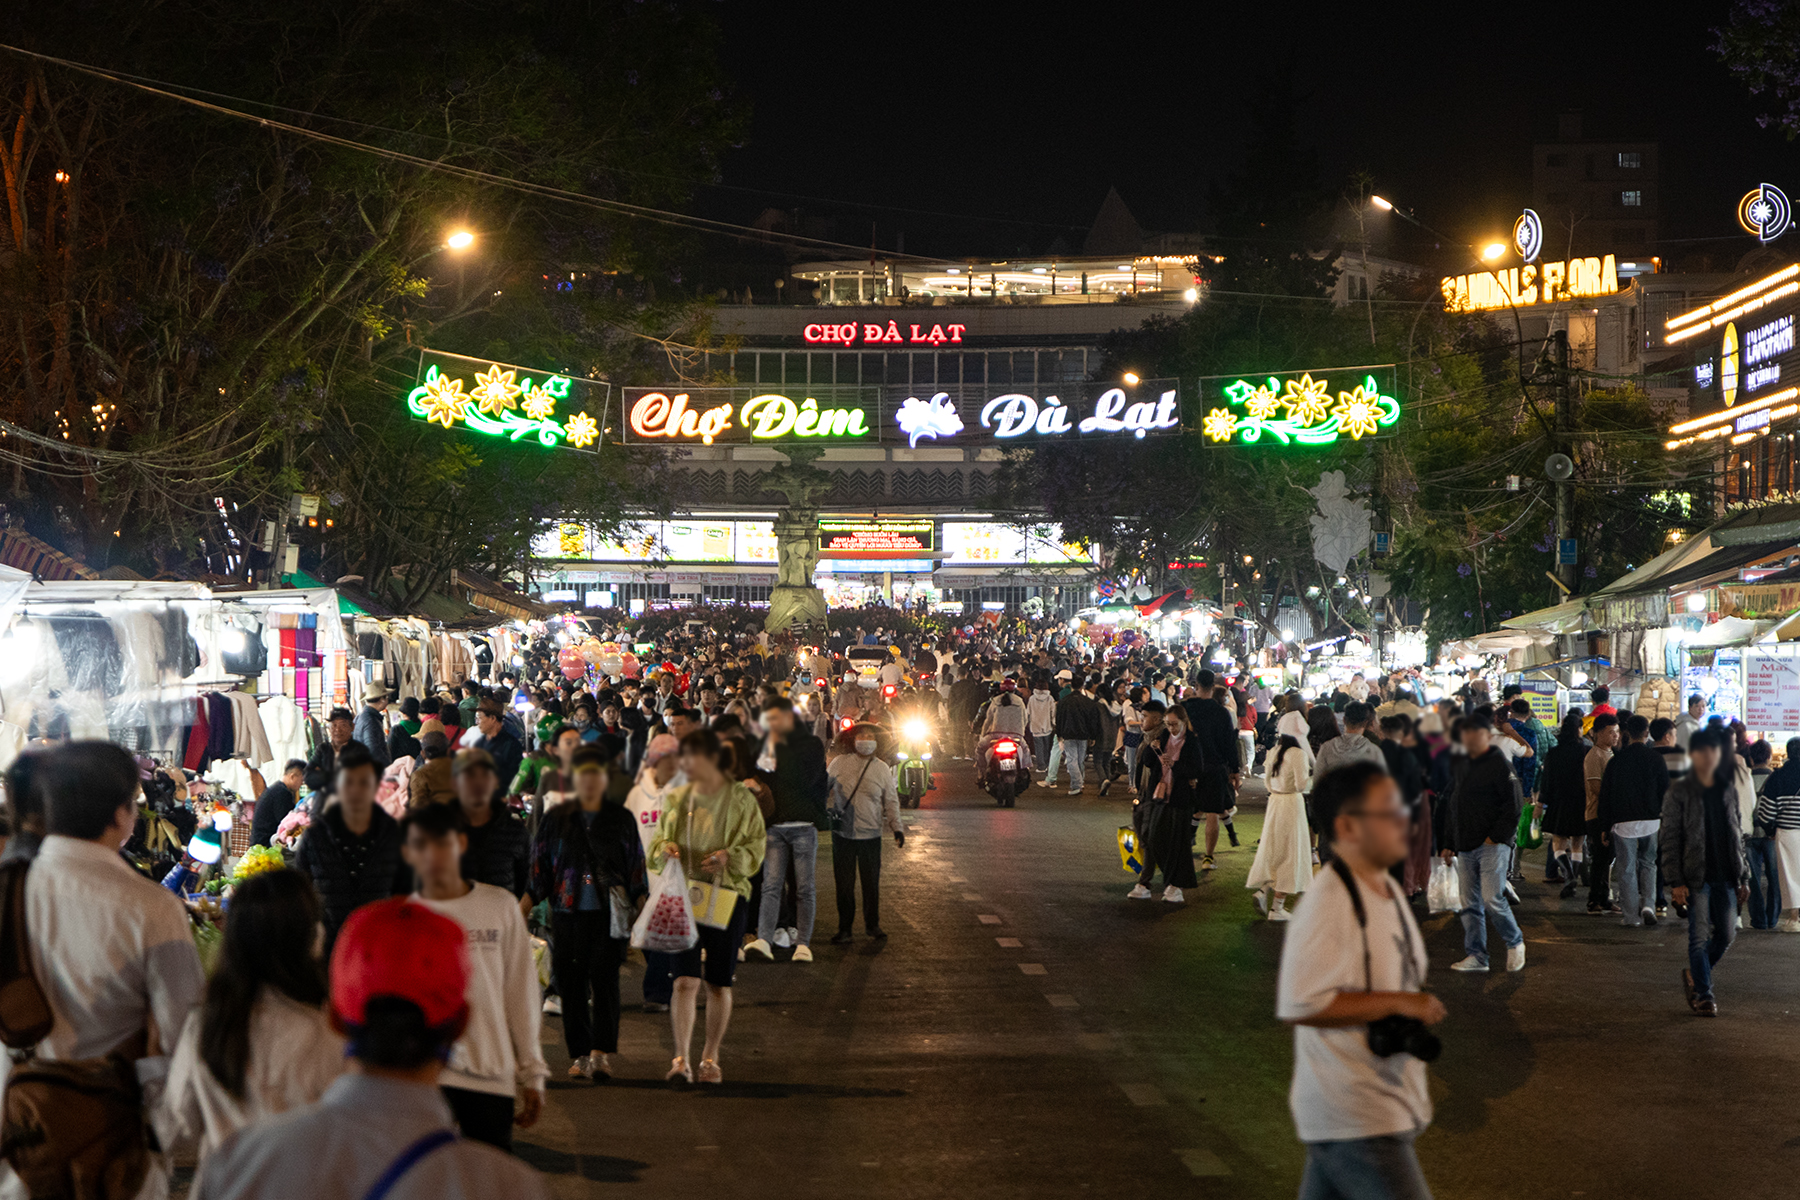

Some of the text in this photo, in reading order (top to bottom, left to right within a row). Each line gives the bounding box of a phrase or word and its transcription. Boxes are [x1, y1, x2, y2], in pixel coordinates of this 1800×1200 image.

[803, 319, 966, 347] CHỢ ĐÀ LẠT
[630, 388, 1179, 445] Chợ Đêm Đà Lạt
[1535, 682, 1556, 691] TRANG
